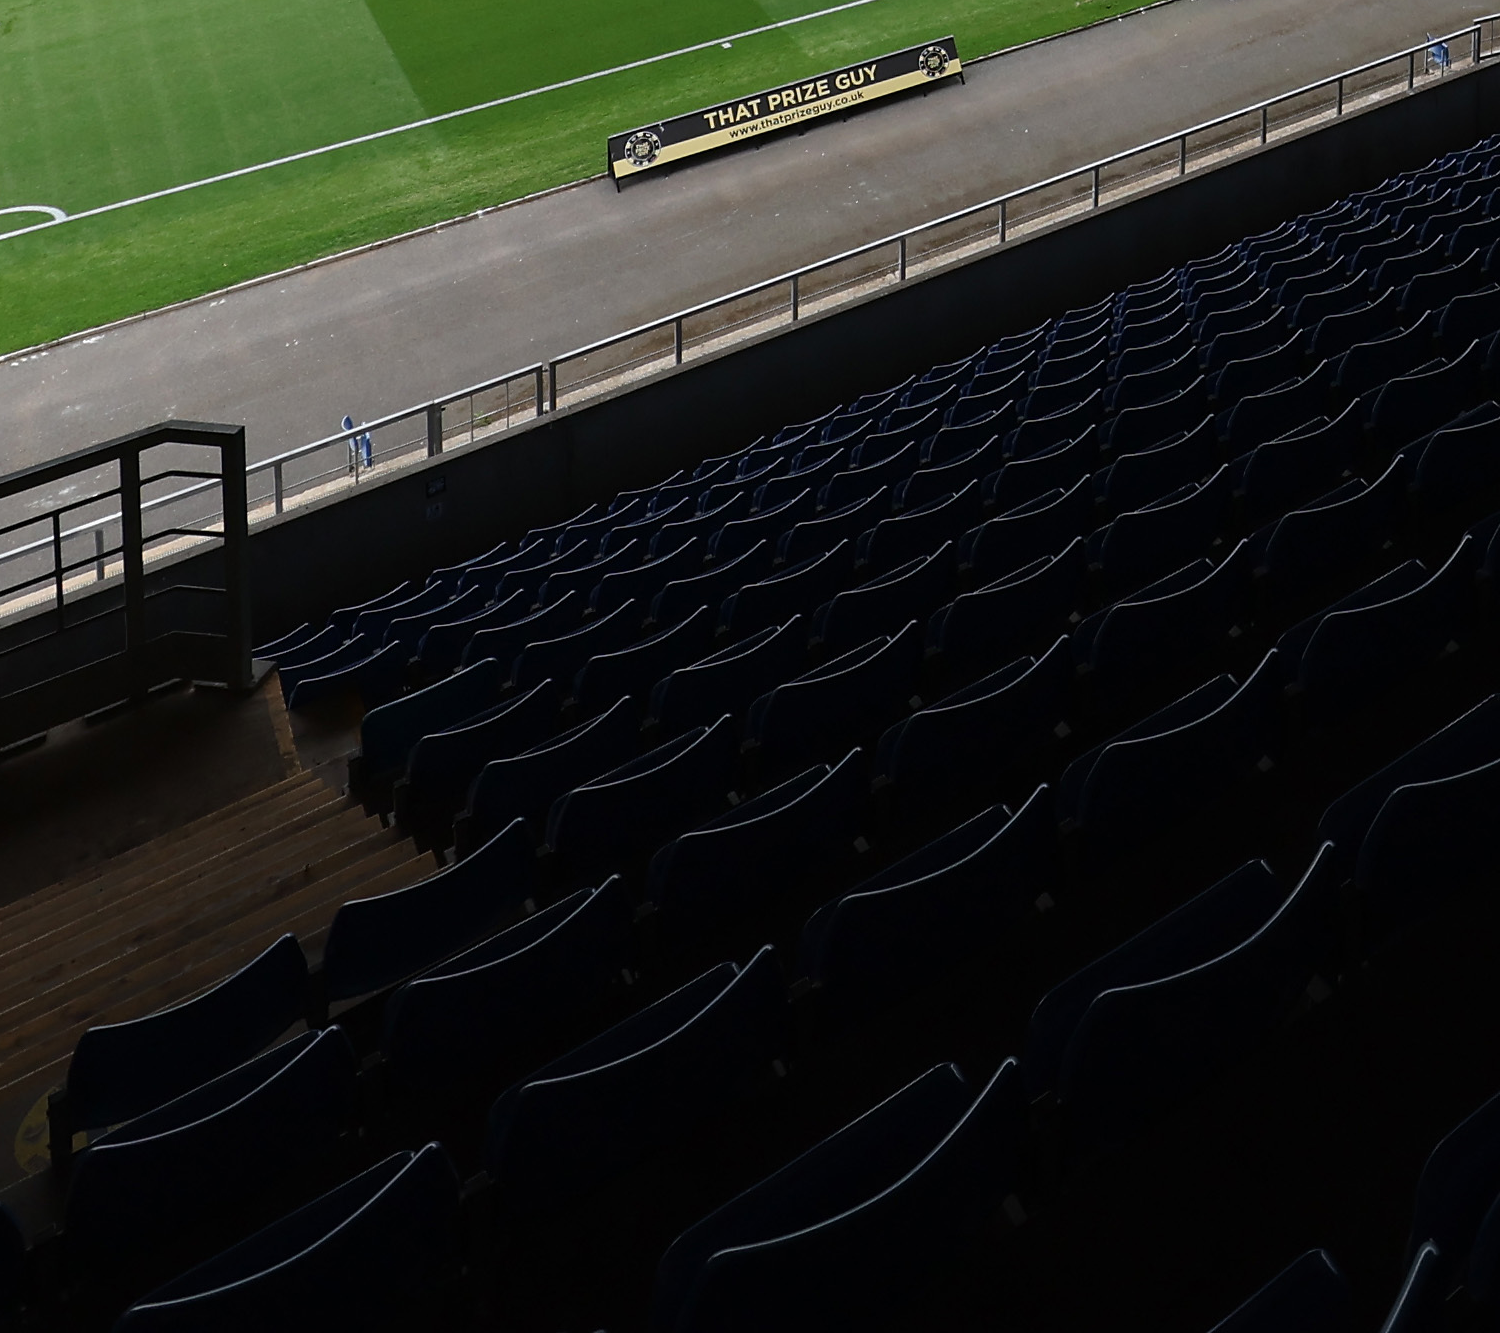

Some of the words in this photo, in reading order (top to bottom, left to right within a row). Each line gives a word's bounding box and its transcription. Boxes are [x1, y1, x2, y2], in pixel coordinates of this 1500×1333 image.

[704, 97, 761, 129] THAT
[768, 80, 831, 115] PRIZE
[835, 64, 877, 91] GUY
[729, 90, 864, 140] www.thatprizeguy.co.uk
